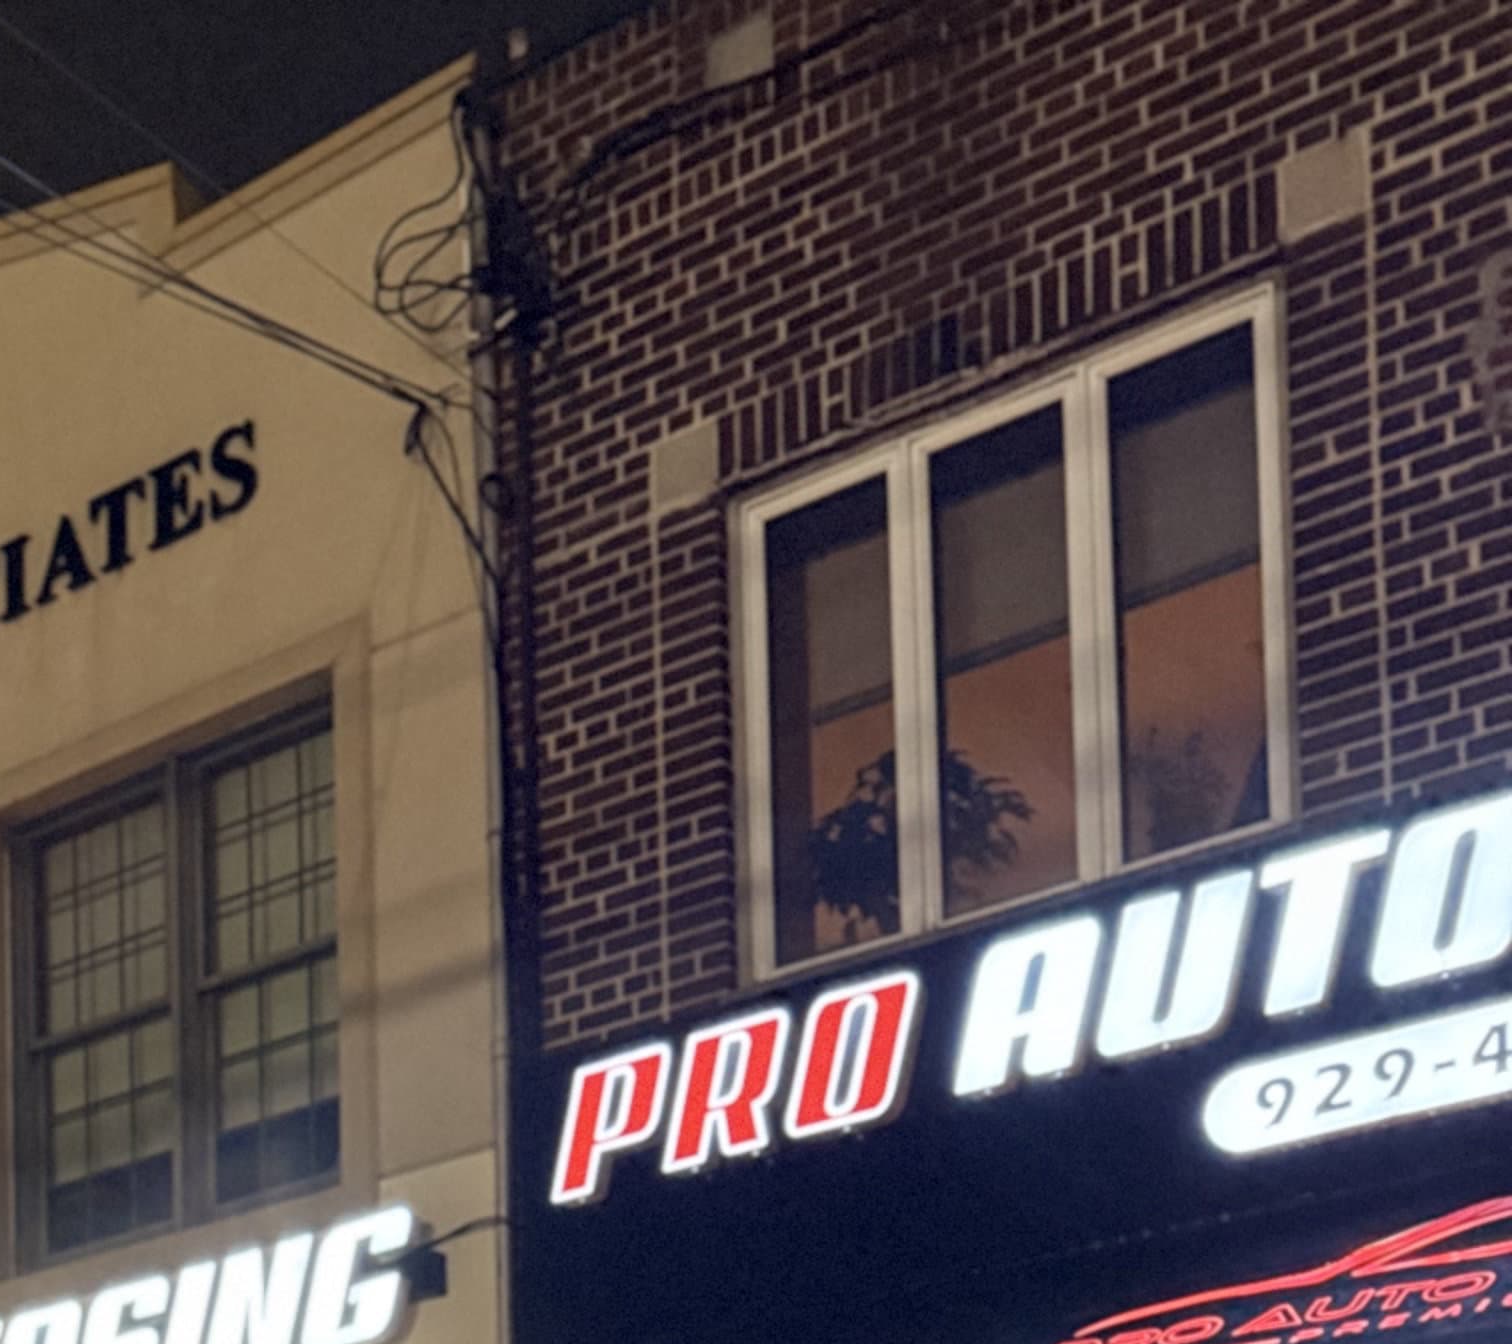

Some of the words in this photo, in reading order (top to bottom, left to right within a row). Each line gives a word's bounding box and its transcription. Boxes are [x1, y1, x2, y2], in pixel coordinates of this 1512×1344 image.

[550, 970, 920, 1206] PRO
[951, 791, 1512, 1098] AUTO
[1255, 1020, 1512, 1130] 929-4
[1231, 1270, 1497, 1338] AUTO
